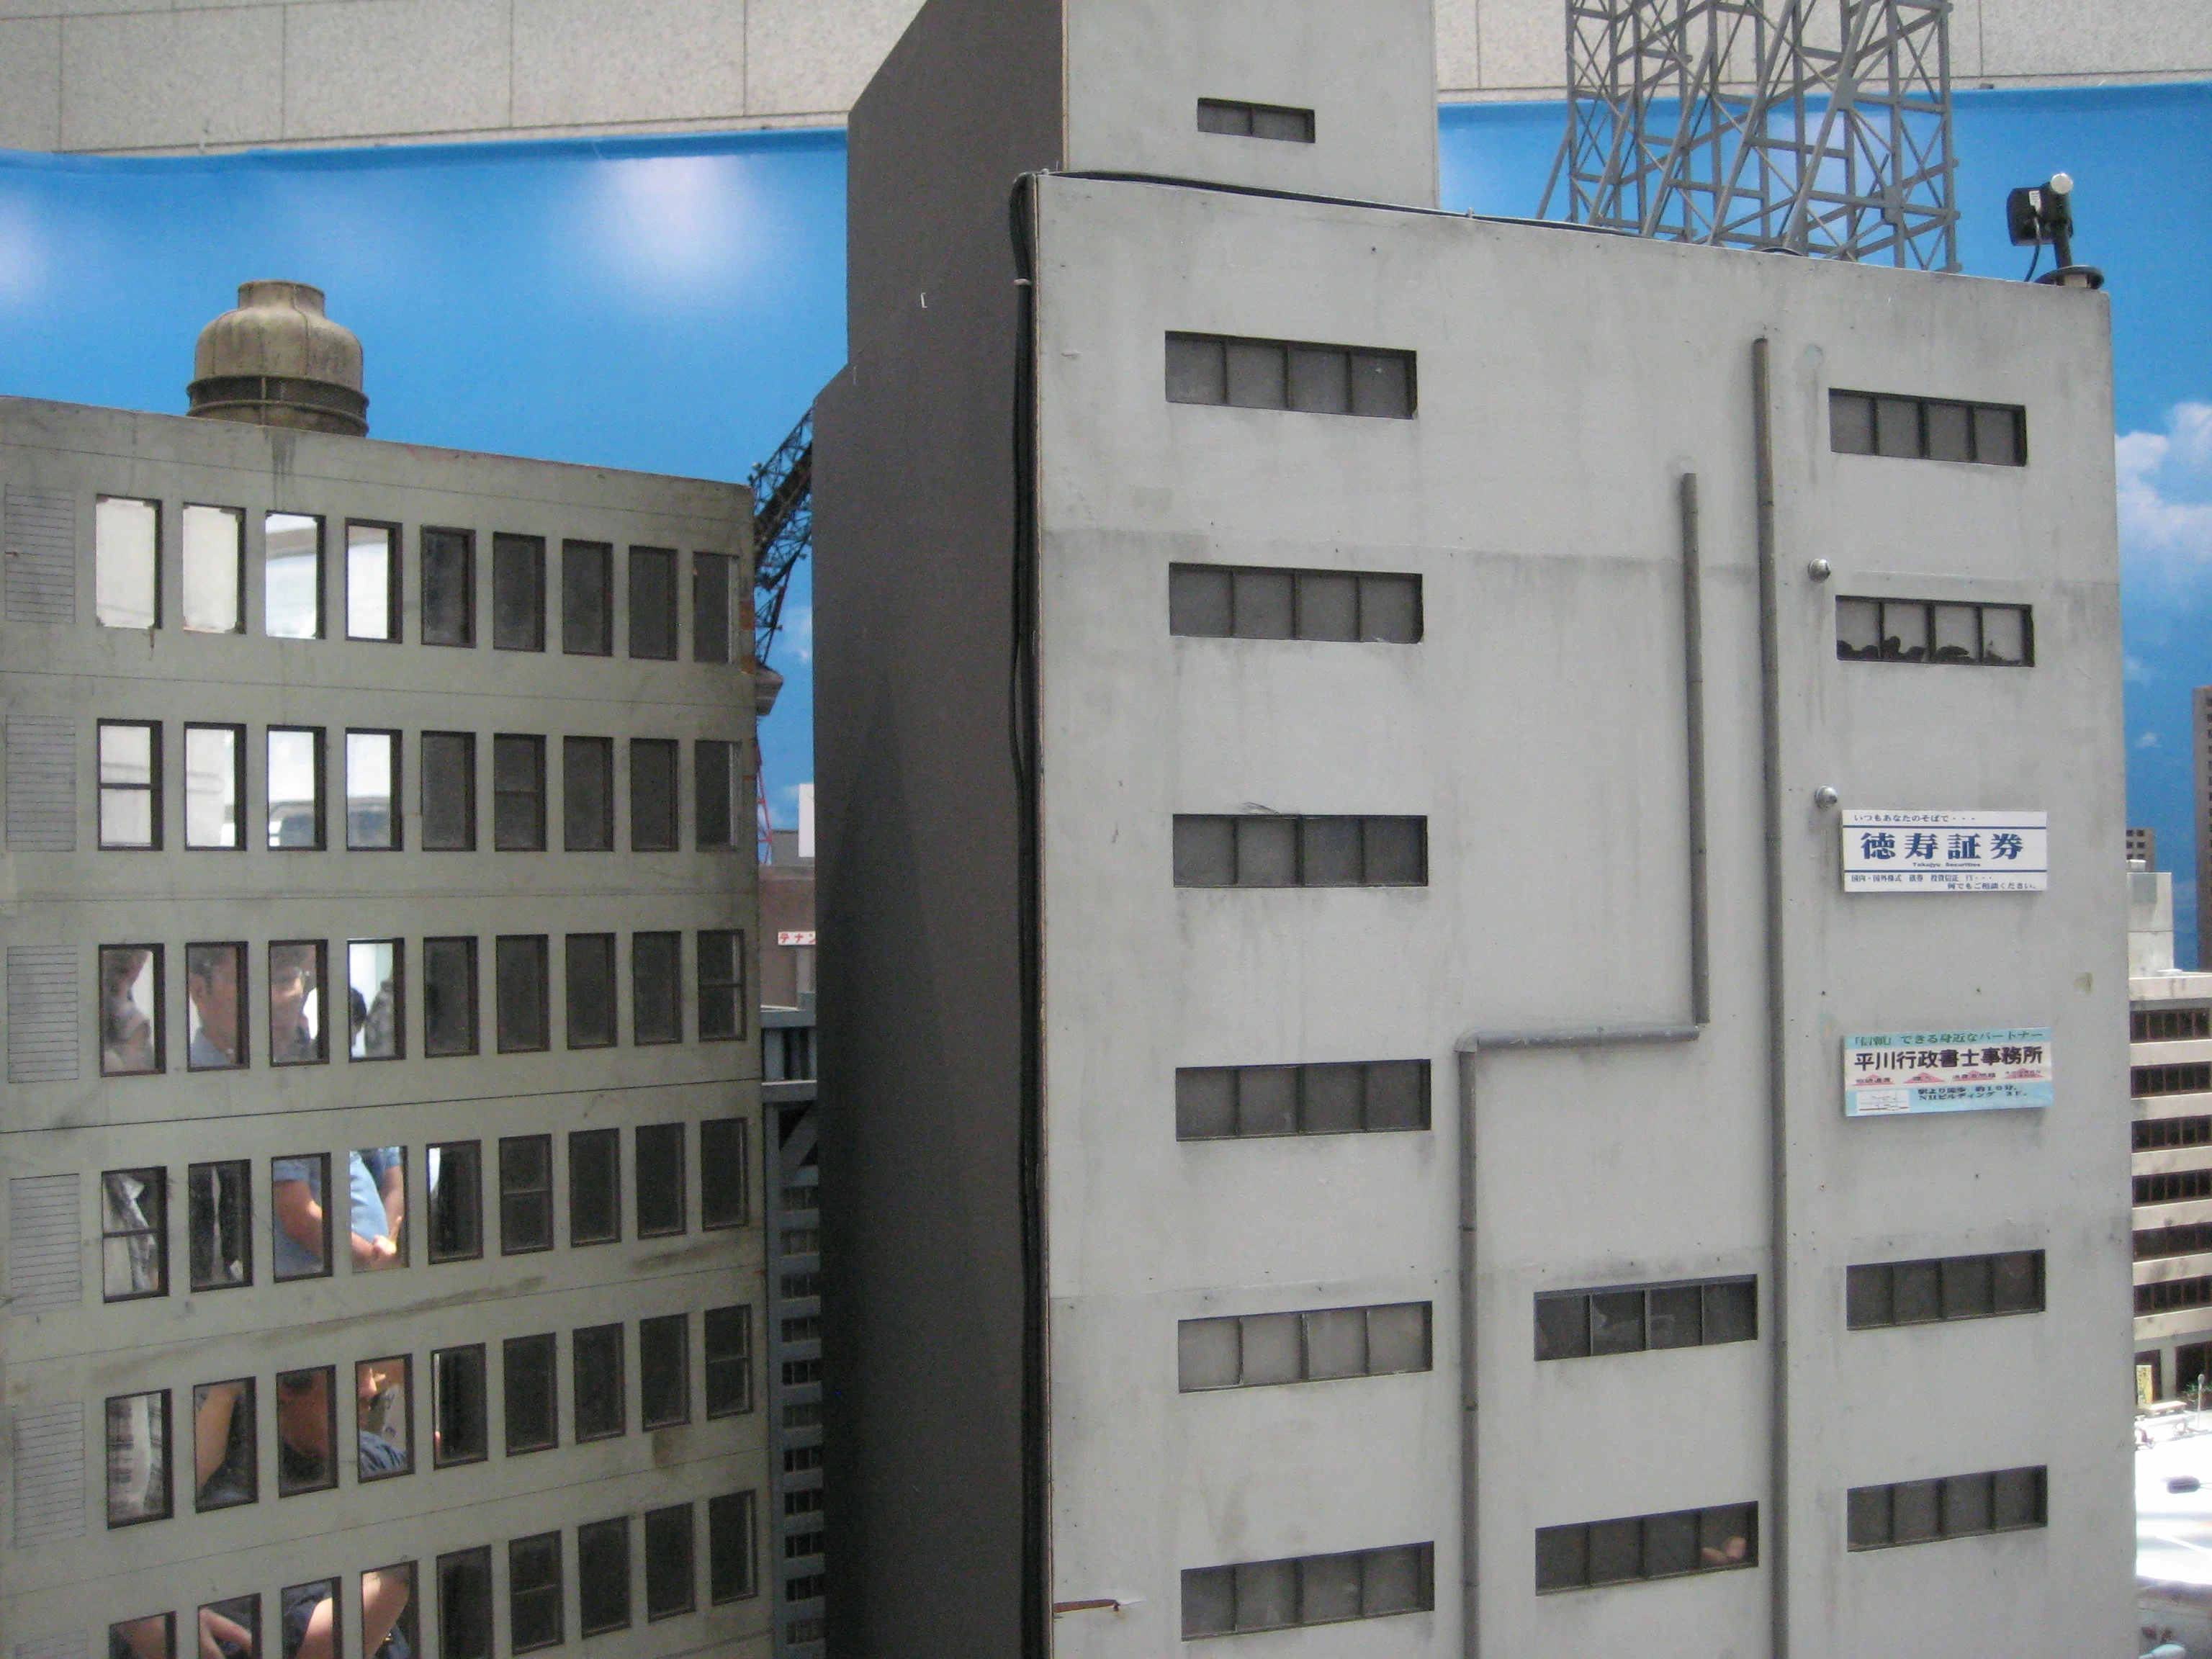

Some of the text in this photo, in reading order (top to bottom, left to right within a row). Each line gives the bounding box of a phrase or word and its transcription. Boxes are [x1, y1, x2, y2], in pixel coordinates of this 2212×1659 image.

[1861, 832, 2024, 860] 徳寿証券
[1854, 1046, 2042, 1071] 平川行政書士事務所
